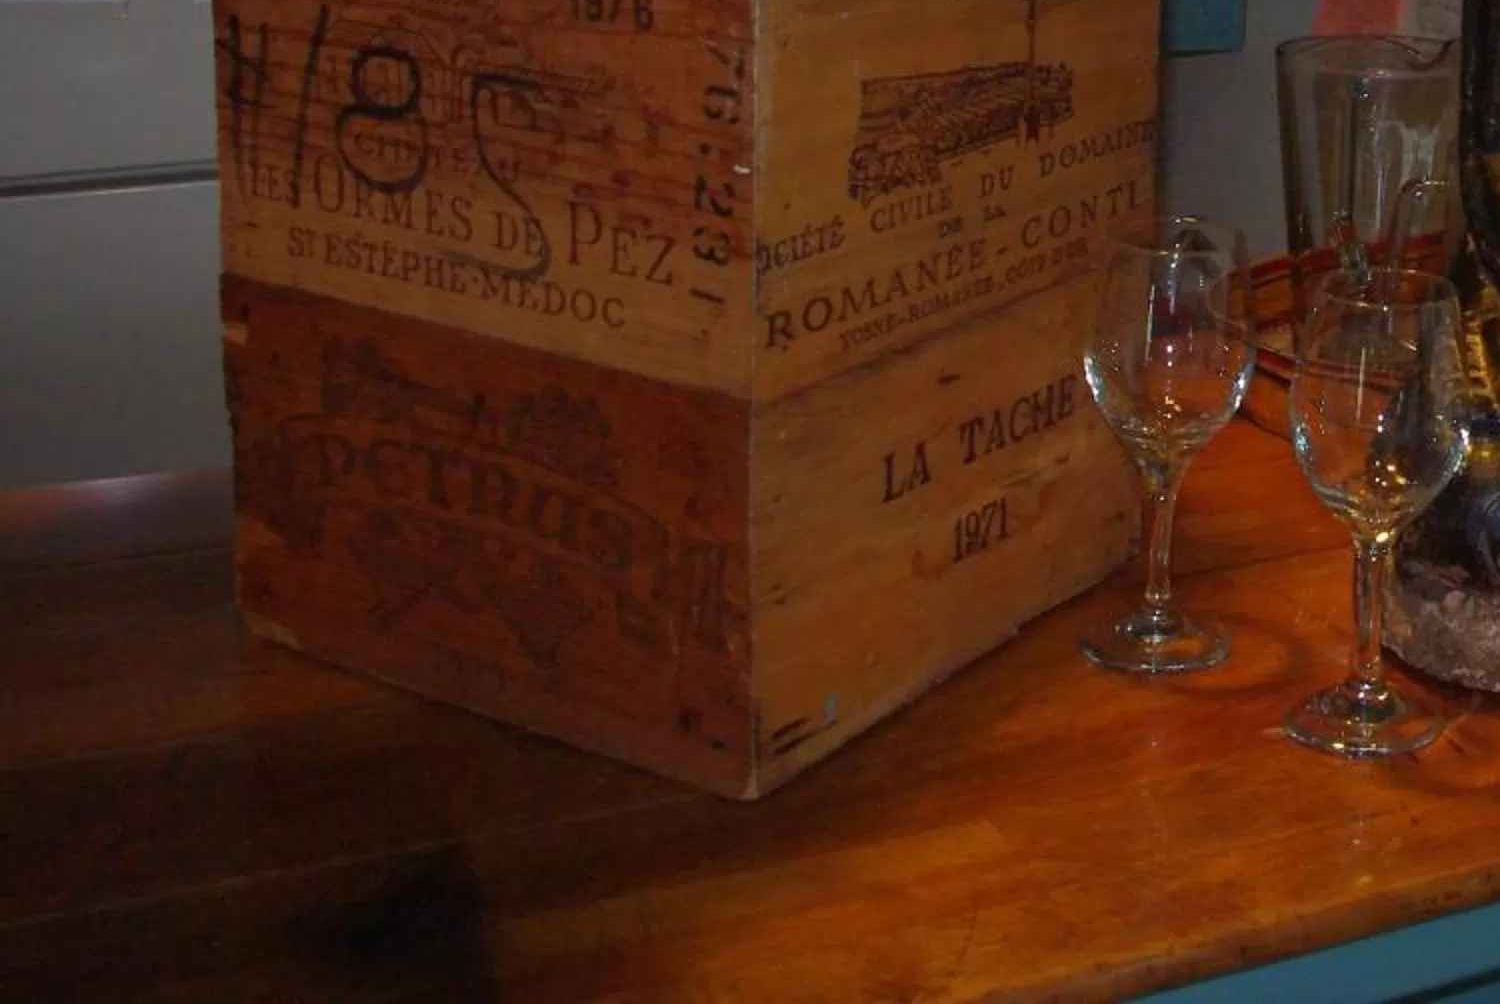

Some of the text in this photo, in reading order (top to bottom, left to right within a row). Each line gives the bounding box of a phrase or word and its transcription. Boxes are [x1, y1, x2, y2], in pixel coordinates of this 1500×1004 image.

[313, 153, 474, 243] ORMES
[493, 209, 544, 258] DE
[567, 199, 677, 286] PEZ
[869, 184, 954, 235] CIVILE
[979, 169, 1016, 201] DU
[880, 440, 932, 504] LA
[951, 496, 1012, 564] 1971
